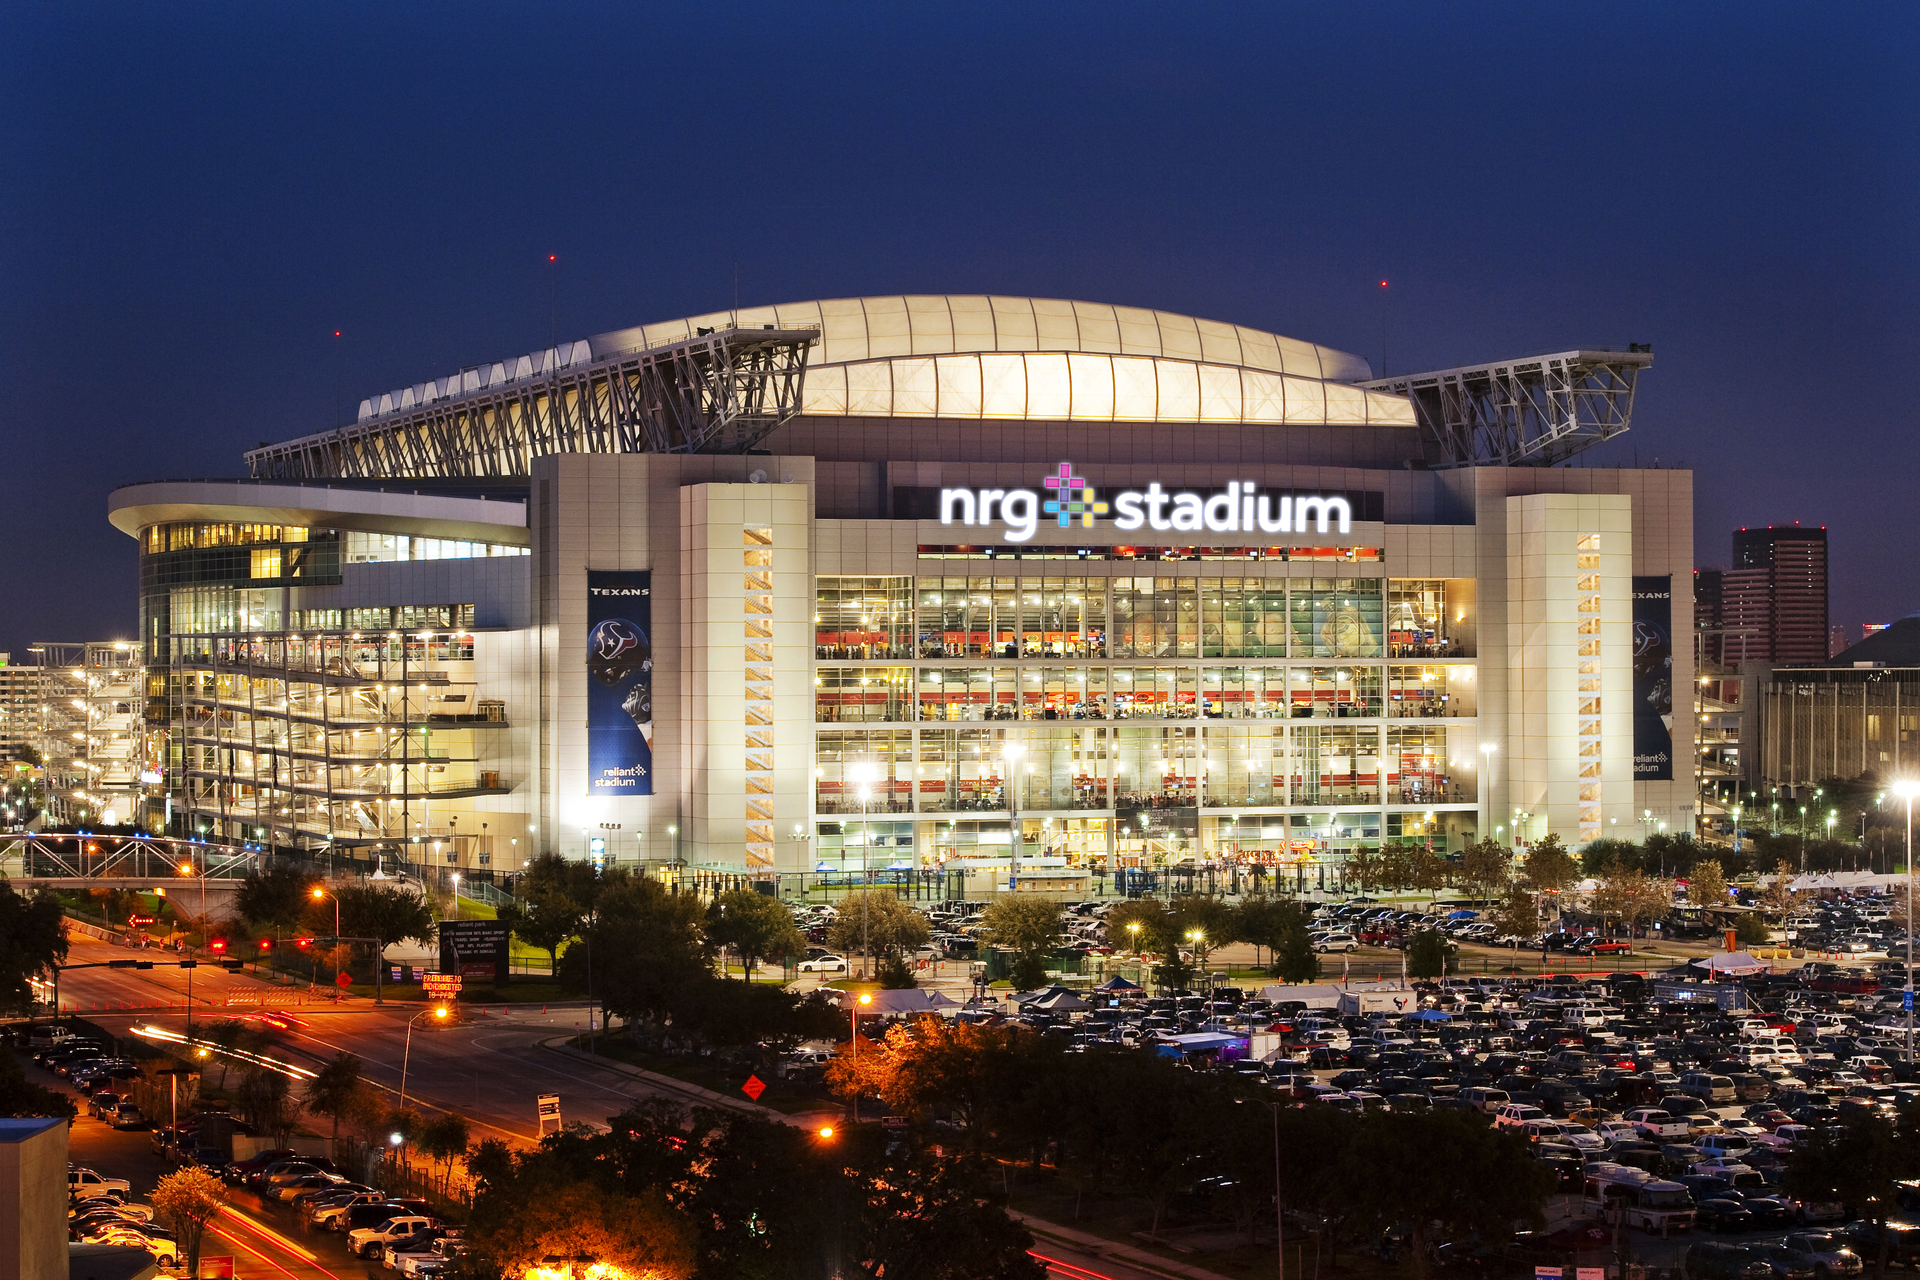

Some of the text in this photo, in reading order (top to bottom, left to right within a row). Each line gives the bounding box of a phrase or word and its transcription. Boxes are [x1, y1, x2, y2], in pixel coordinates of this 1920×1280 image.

[940, 481, 1351, 542] nrg stadium
[590, 587, 650, 596] TEXANS
[603, 766, 636, 777] reliant
[1634, 763, 1659, 772] adium
[594, 777, 636, 788] stadium
